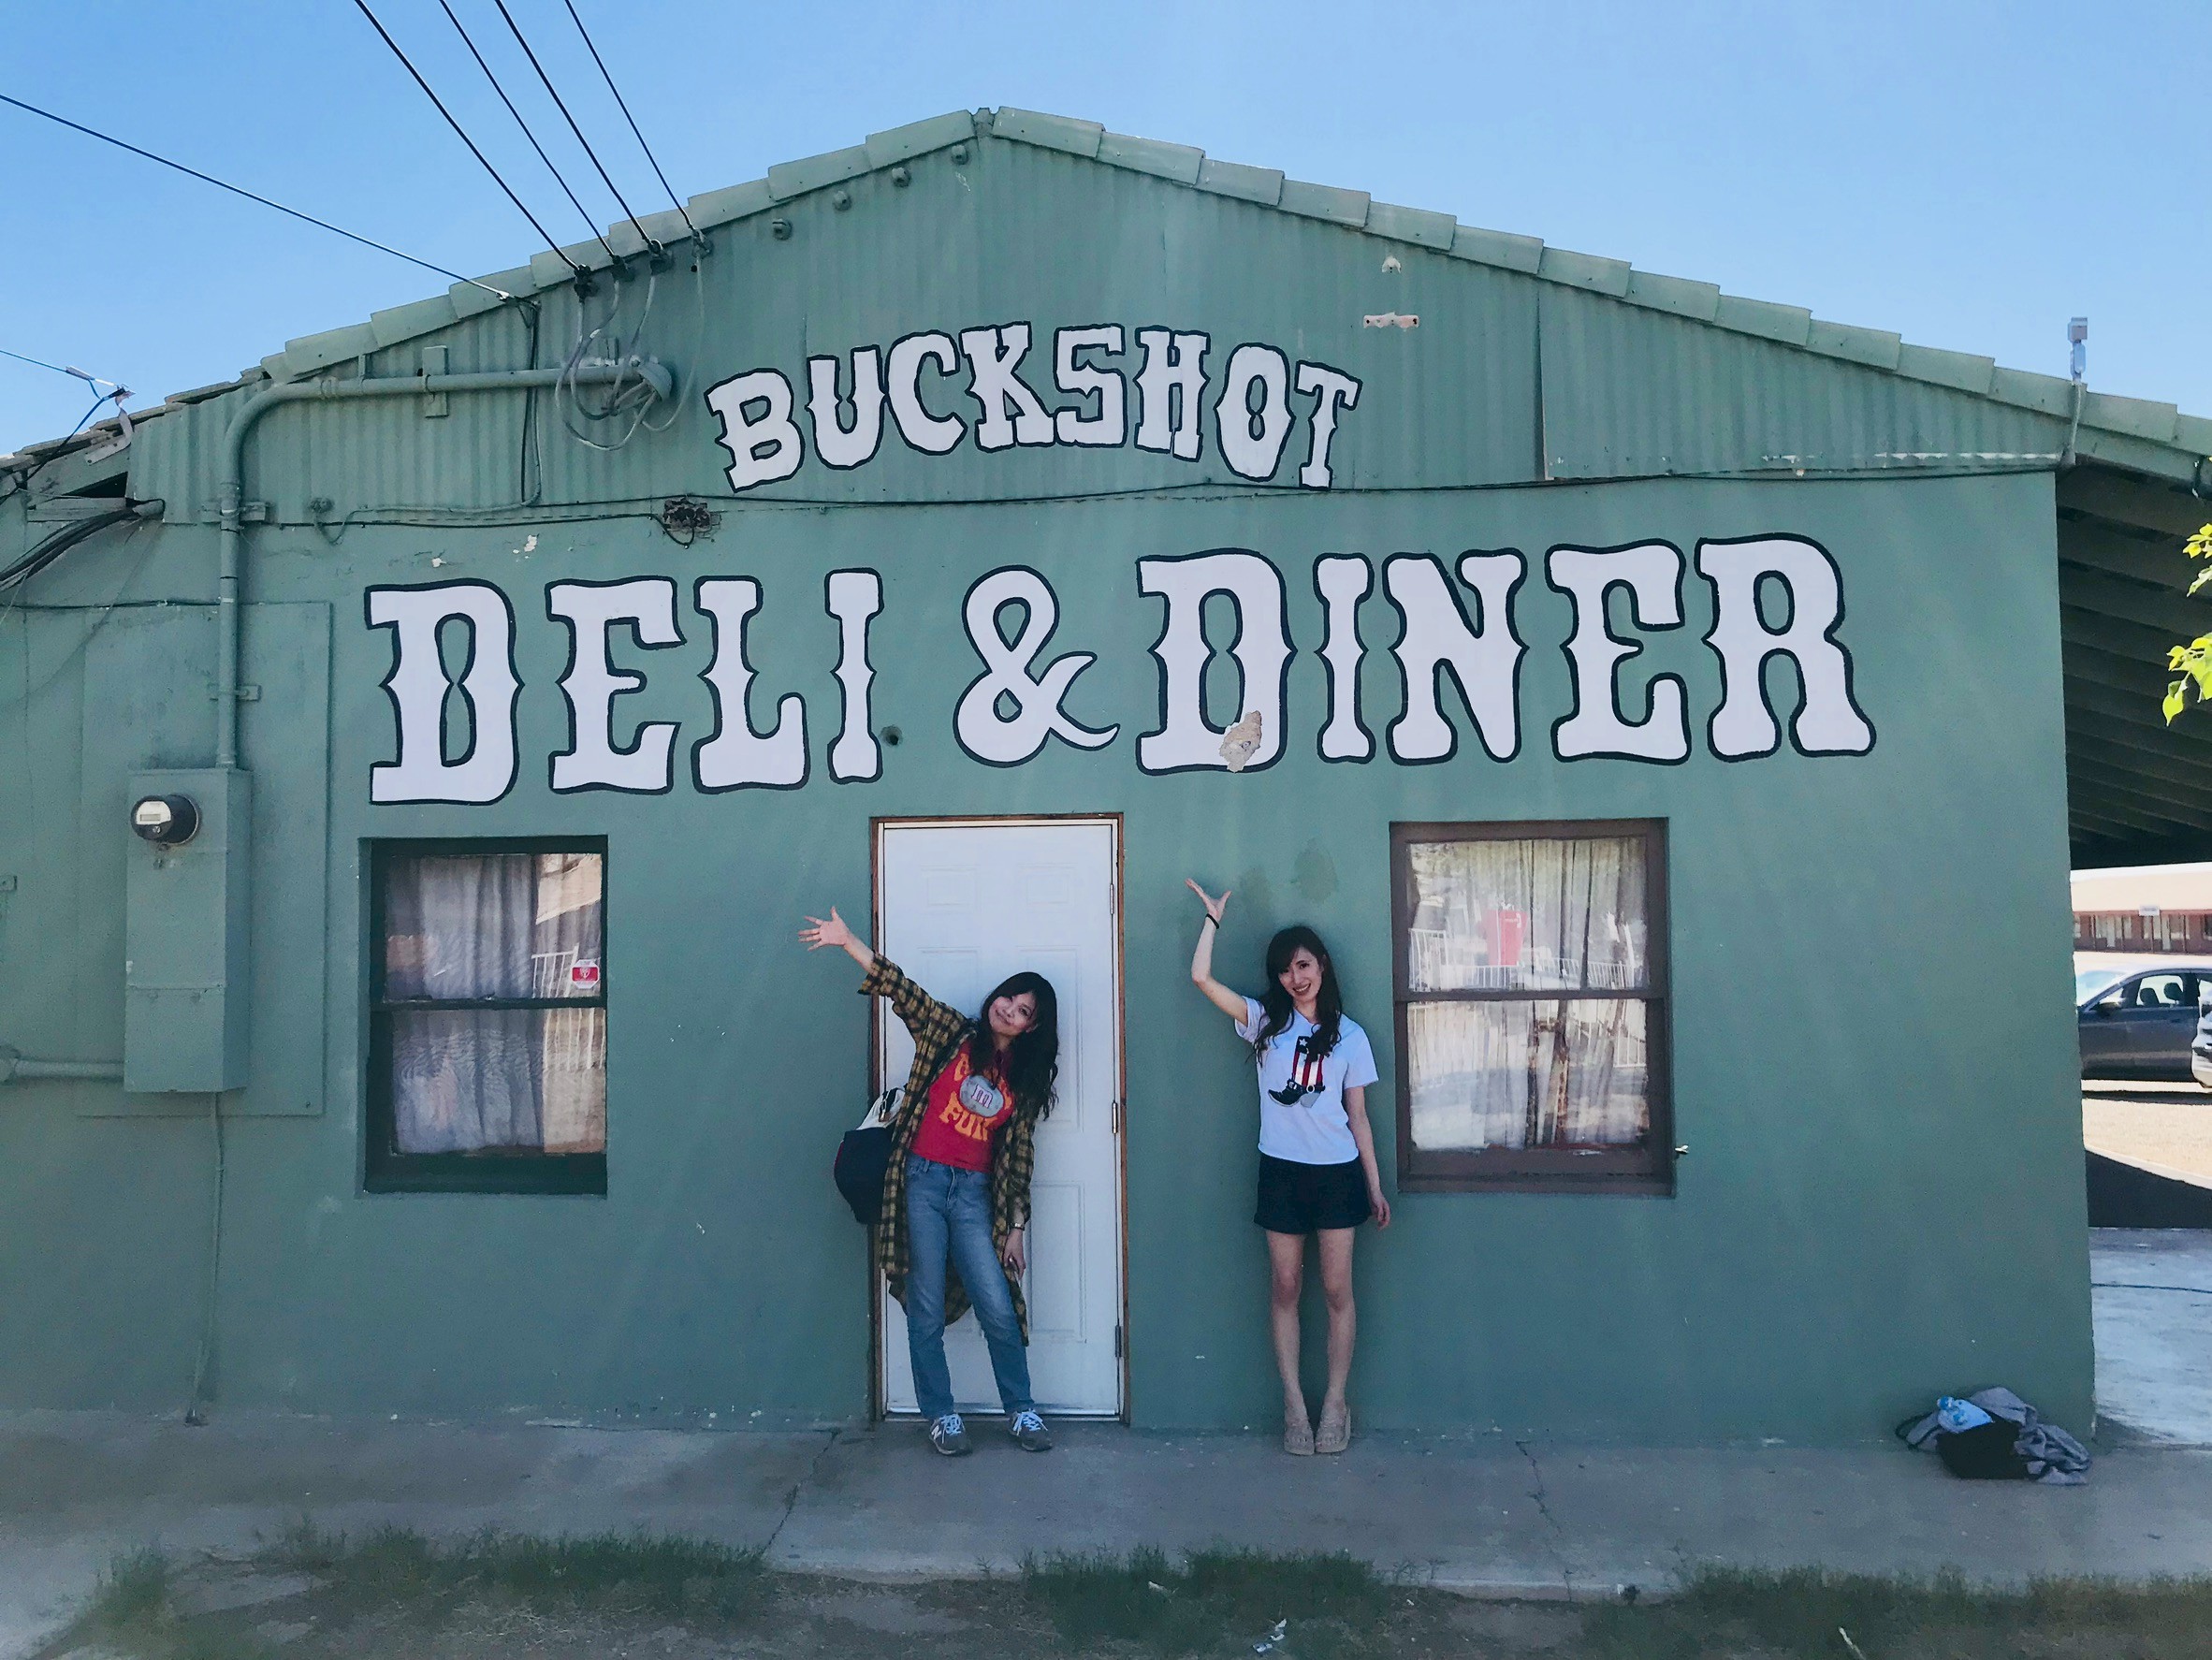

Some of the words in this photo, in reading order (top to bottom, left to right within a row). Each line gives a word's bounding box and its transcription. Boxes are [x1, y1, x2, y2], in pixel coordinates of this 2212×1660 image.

[704, 321, 1362, 491] BUCKSHOT
[364, 567, 883, 806] DELI
[953, 564, 1121, 767] &
[1136, 531, 1877, 776] DINER
